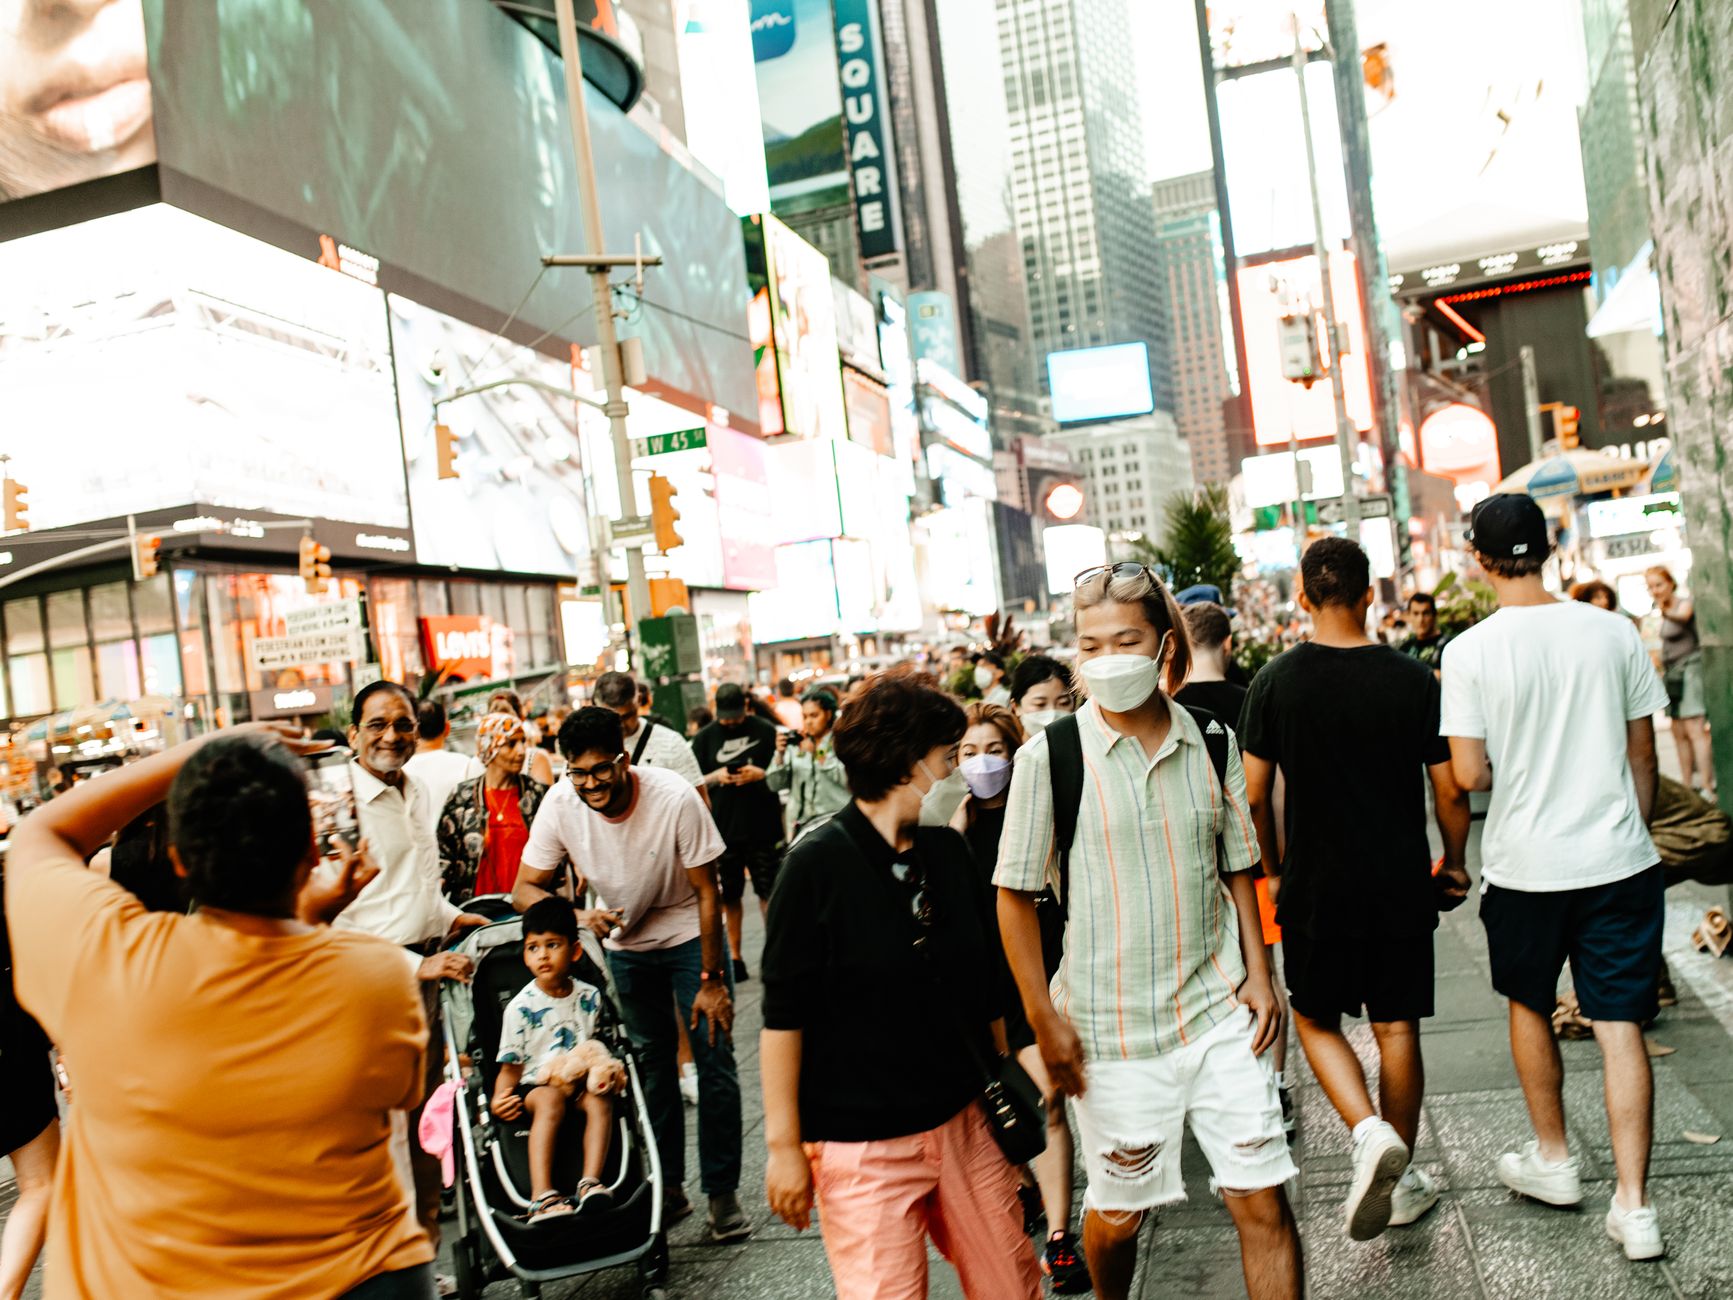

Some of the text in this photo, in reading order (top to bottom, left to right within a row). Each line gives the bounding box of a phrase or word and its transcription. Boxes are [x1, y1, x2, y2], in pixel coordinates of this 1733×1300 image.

[839, 22, 884, 233] SQUARE
[650, 436, 664, 454] W
[670, 432, 689, 450] 45
[256, 638, 304, 653] PEDESTRIAN
